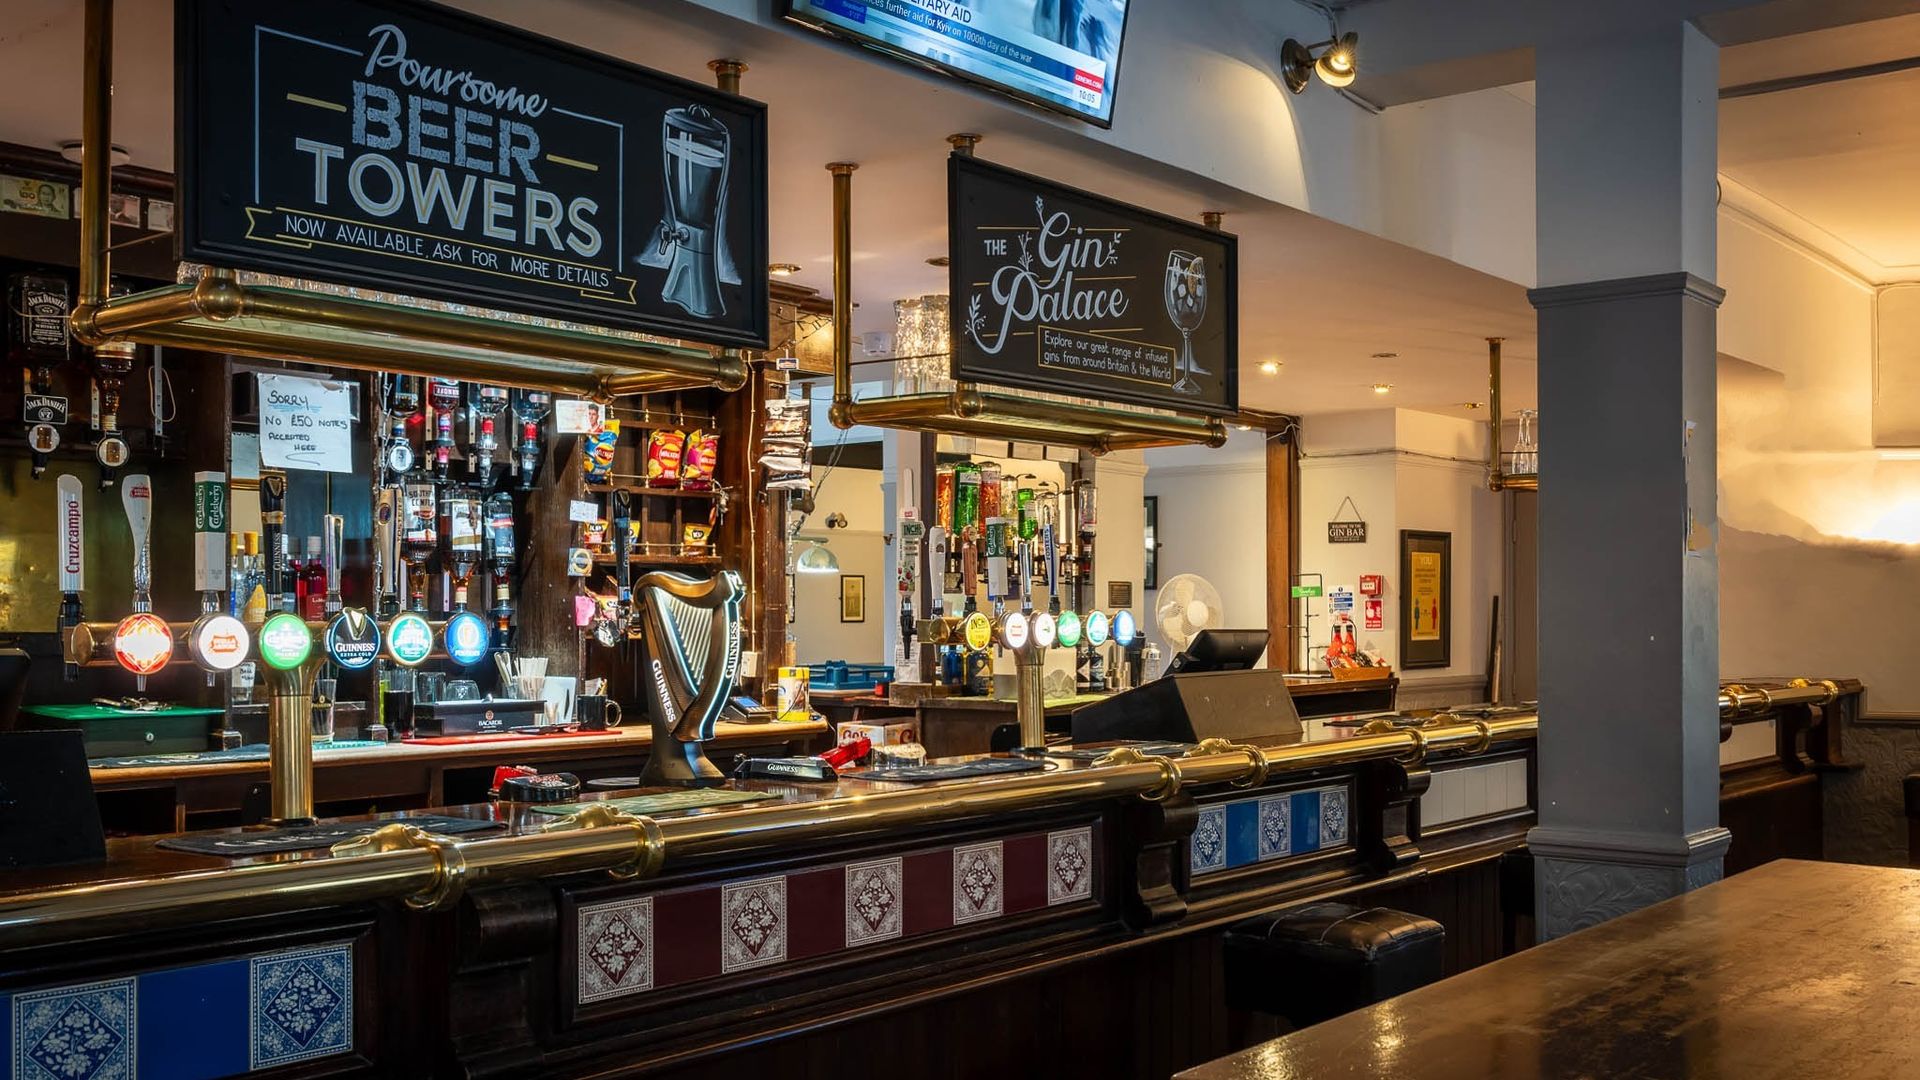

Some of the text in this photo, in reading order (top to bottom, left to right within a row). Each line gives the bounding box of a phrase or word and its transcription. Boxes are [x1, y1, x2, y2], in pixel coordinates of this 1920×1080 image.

[886, 0, 911, 17] further
[912, 12, 924, 23] aid
[924, 15, 935, 26] for
[936, 19, 952, 33] Kyiv
[952, 28, 962, 36] on
[964, 31, 986, 46] 1000th
[987, 40, 1000, 53] day
[1000, 44, 1008, 54] of
[1009, 47, 1019, 59] the
[1020, 53, 1032, 63] war
[951, 6, 972, 23] AID
[351, 79, 541, 184] BEER
[295, 137, 602, 258] TOWERS
[285, 215, 327, 239] NOW
[433, 242, 464, 263] ASK
[471, 249, 499, 270] FOR
[510, 256, 551, 279] MORE
[557, 264, 610, 288] DETAILS
[984, 211, 1109, 290] THE Gin
[972, 266, 1129, 355] Palace
[1043, 330, 1169, 364] Explore our great range of infused
[1043, 350, 1172, 380] gins from around Britain & the World
[26, 399, 43, 410] JACK
[267, 389, 310, 411] SORRY
[291, 414, 314, 428] £50
[318, 419, 348, 430] NOTES
[208, 485, 224, 529] Carlsberg
[65, 500, 81, 574] Cruzcampo
[273, 532, 281, 571] GUINNESS
[1329, 528, 1365, 537] GIN BAR
[335, 642, 375, 652] GUINNESS
[725, 621, 739, 679] GUINNESS
[652, 659, 676, 722] GUINNESS
[767, 762, 800, 773] GUINNESS
